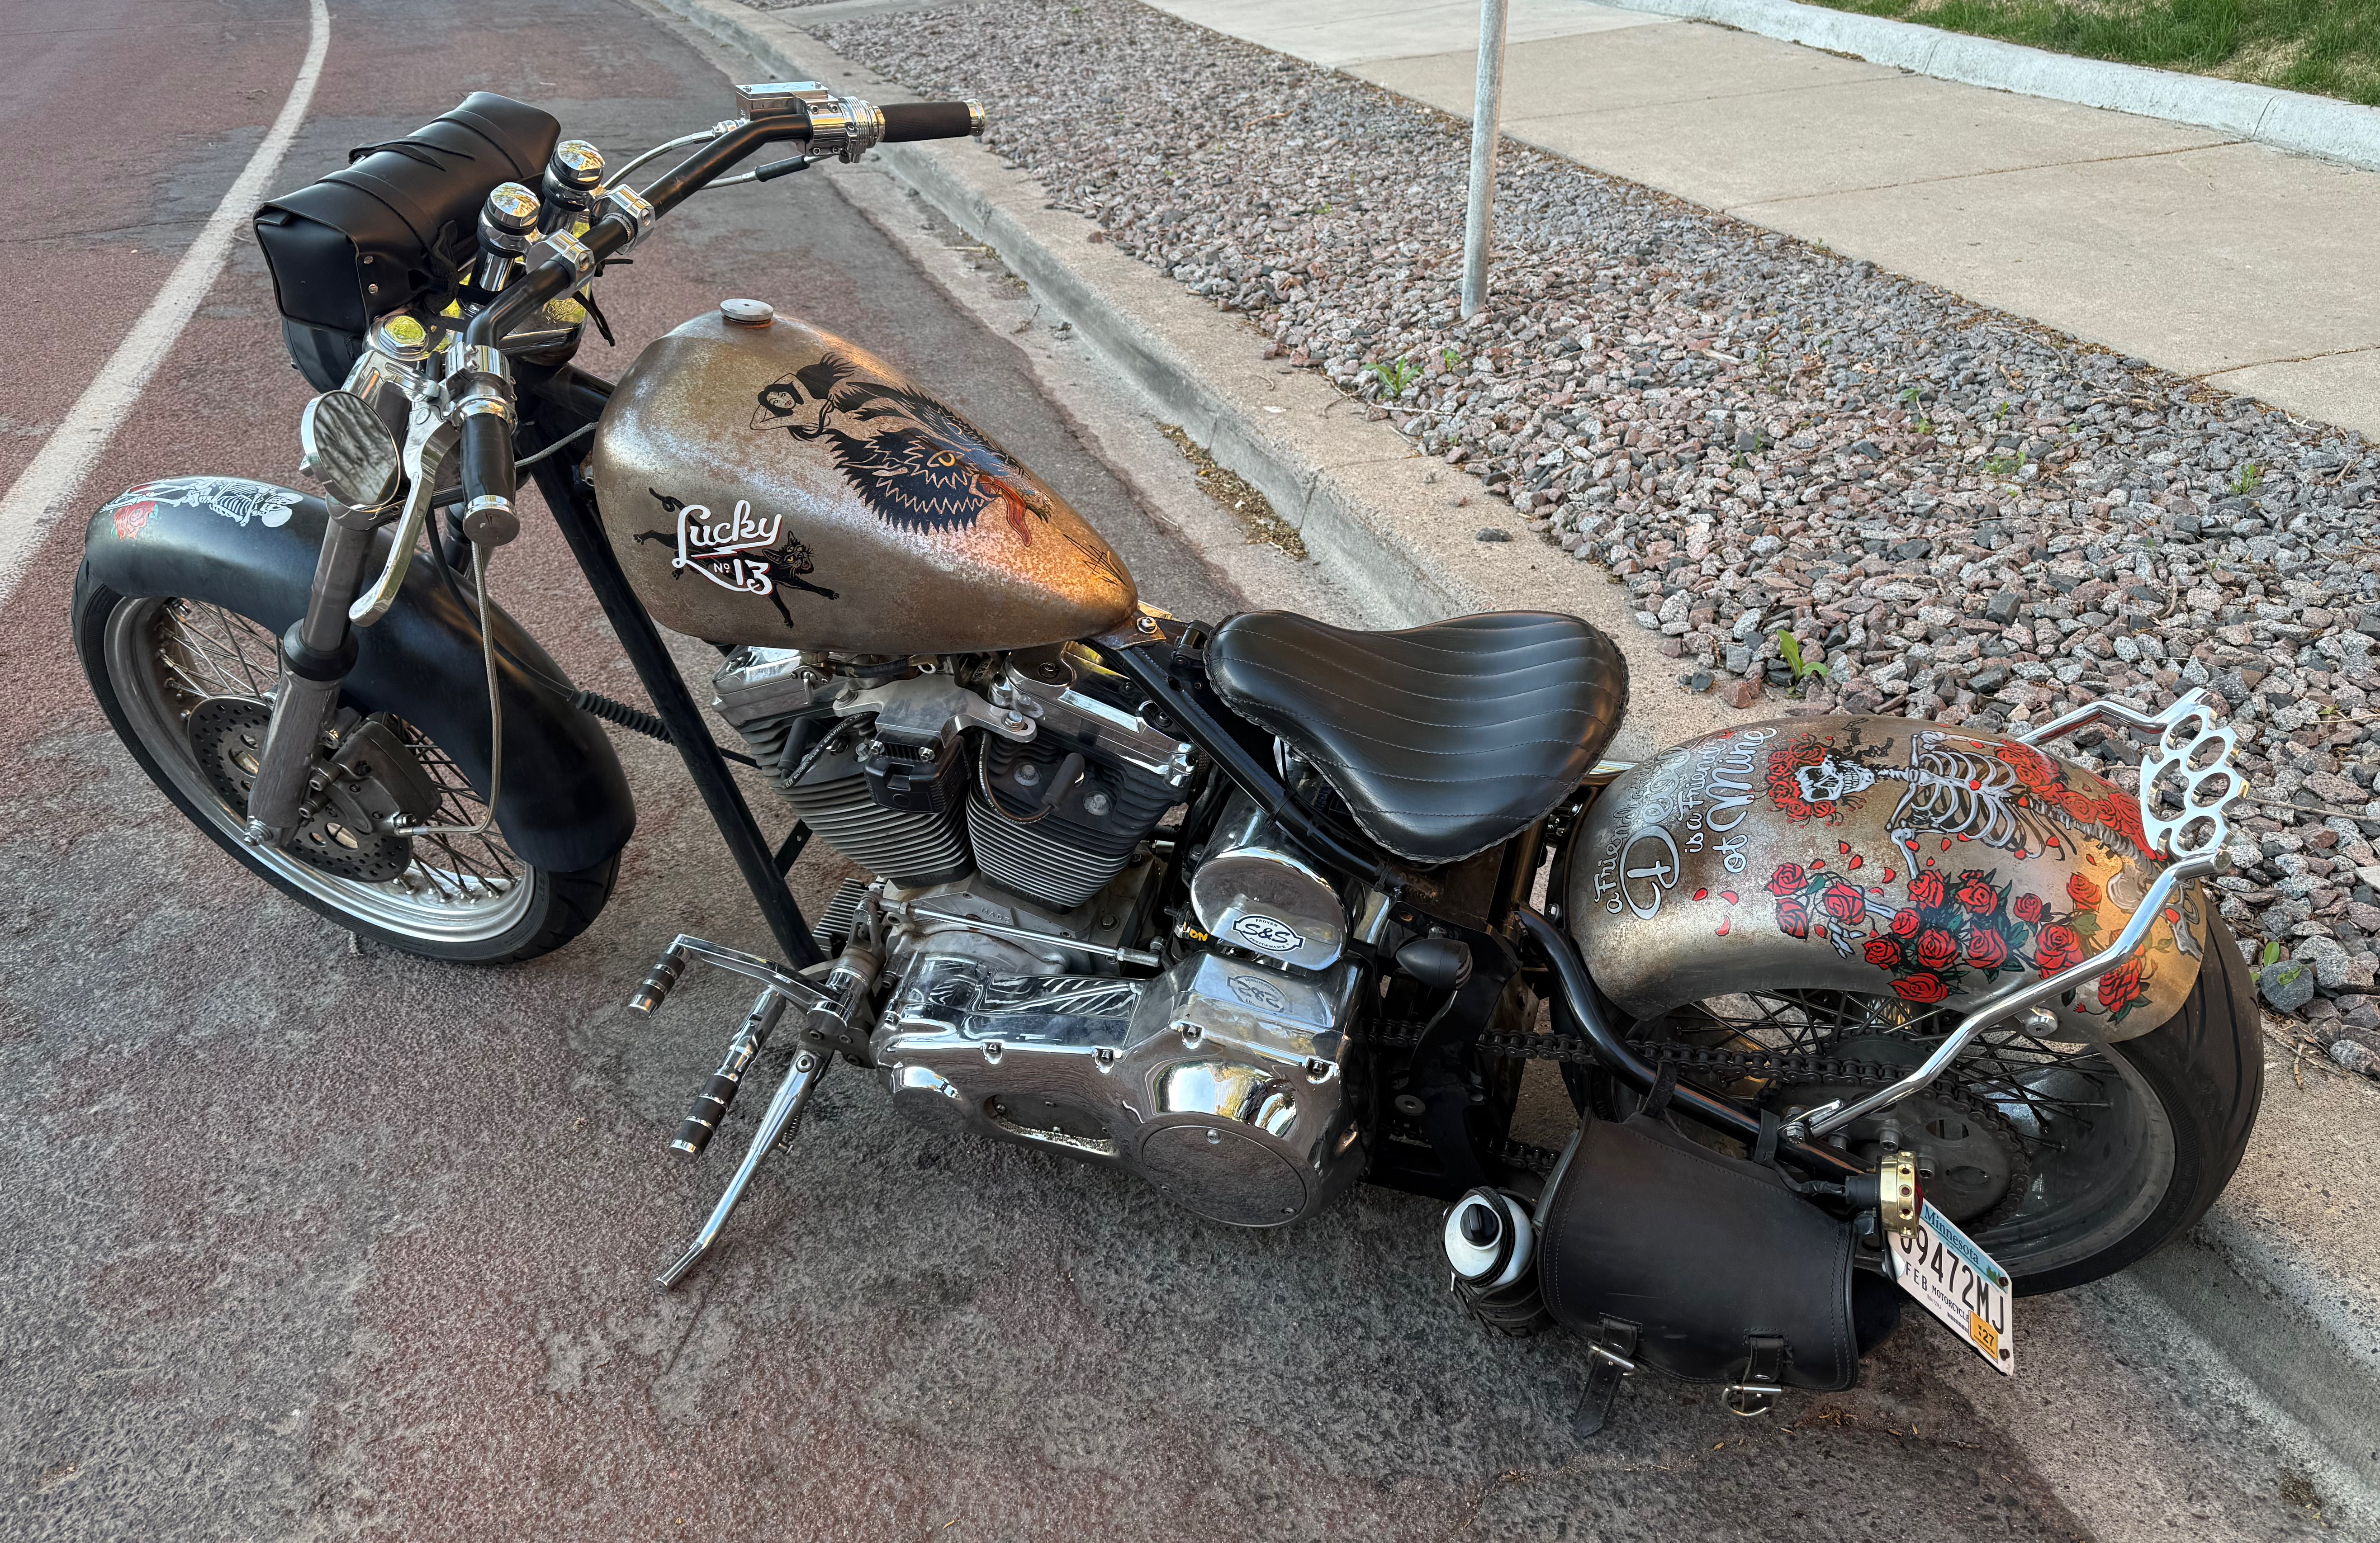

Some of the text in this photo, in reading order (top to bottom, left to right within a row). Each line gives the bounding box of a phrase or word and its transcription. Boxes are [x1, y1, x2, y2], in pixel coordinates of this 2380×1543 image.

[672, 500, 782, 568] Lucky
[733, 559, 773, 595] 13
[1677, 744, 1726, 853] is a Friend
[1705, 727, 1777, 873] of Mine
[980, 907, 1010, 924] MADE
[1606, 891, 1624, 913] a
[1242, 923, 1290, 943] S&S
[1256, 918, 1278, 928] PROVEN
[1249, 937, 1286, 949] PERFORMANCE
[1925, 1204, 1979, 1265] Minnesota
[1906, 1261, 1927, 1292] FEB
[1932, 1285, 1969, 1323] MOTORCYCLE
[1982, 1329, 1995, 1347] 27
